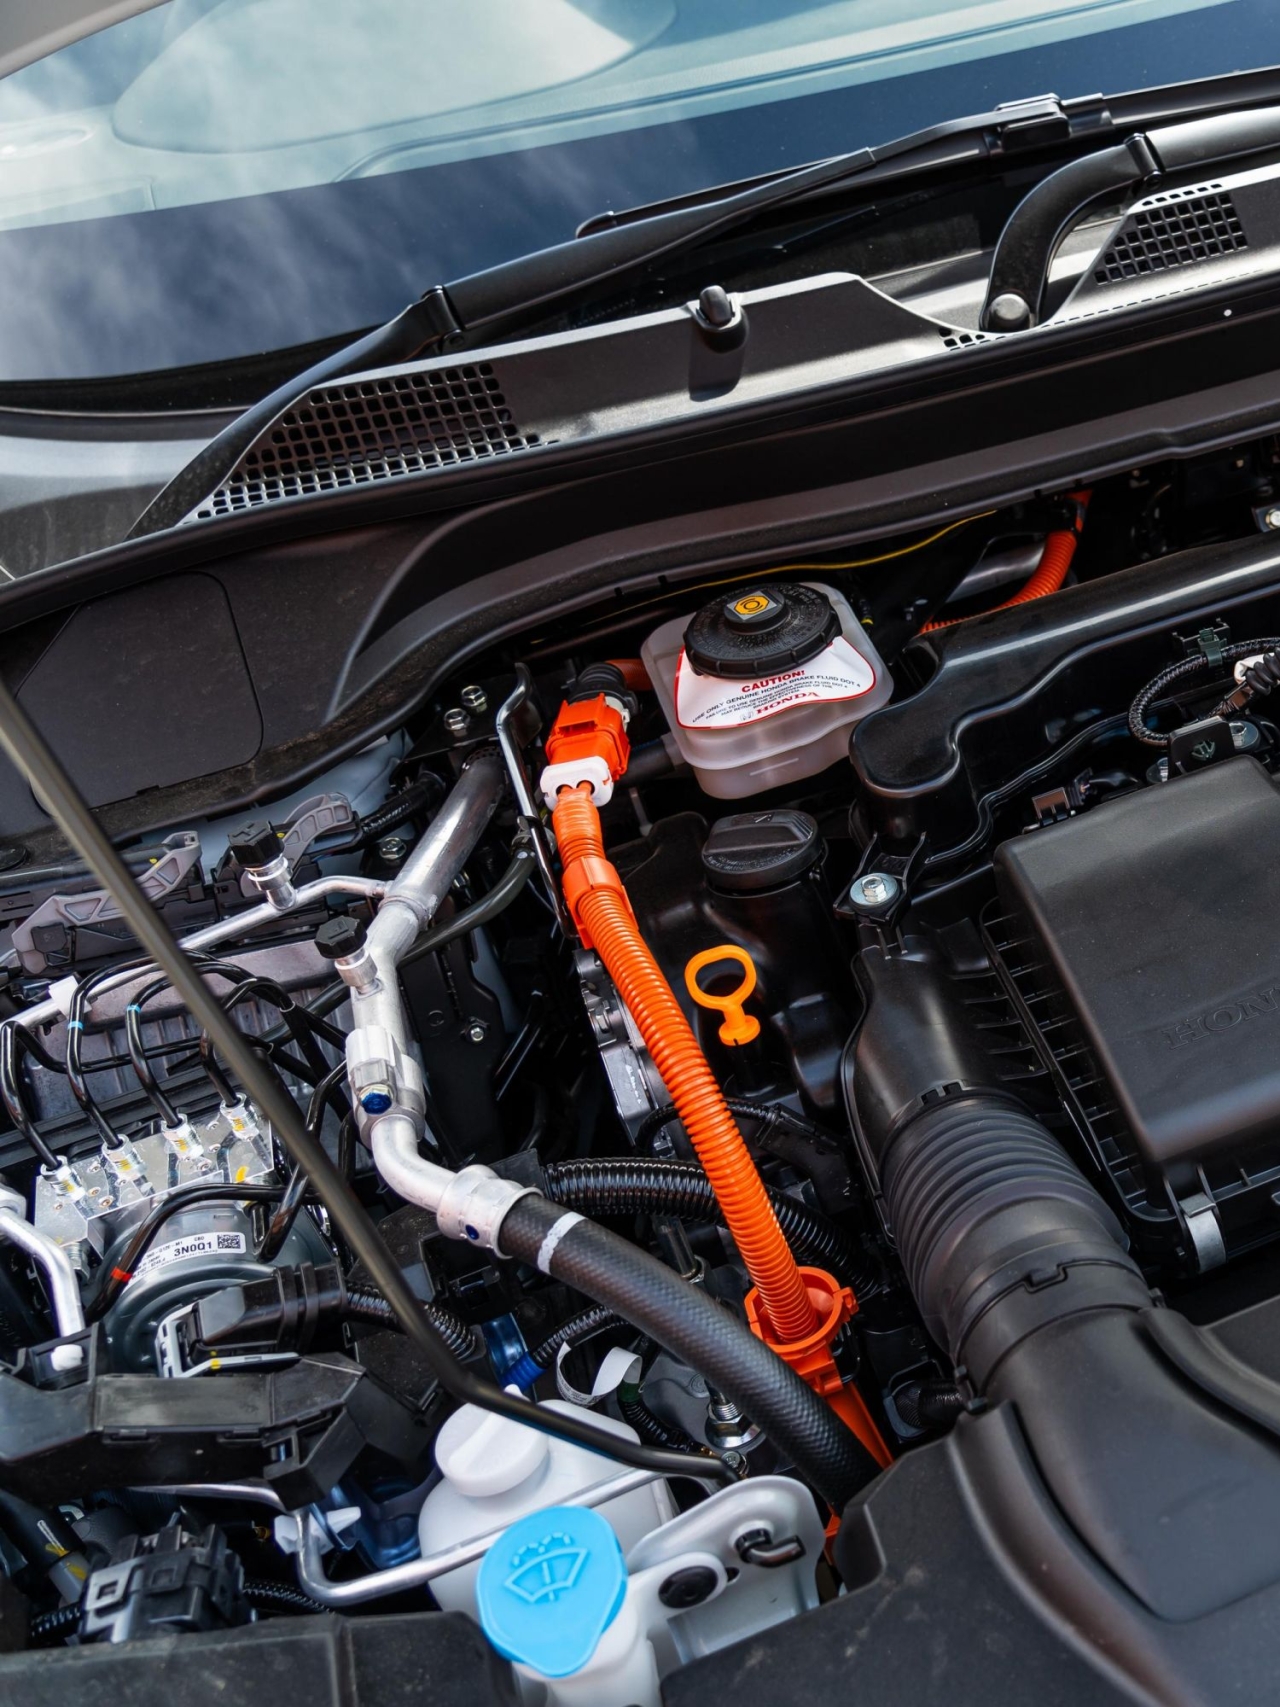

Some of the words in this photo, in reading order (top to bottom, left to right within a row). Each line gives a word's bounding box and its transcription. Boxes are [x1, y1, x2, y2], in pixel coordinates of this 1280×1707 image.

[741, 670, 805, 693] CAUTION!
[692, 712, 704, 723] USE
[706, 702, 724, 714] ONLY
[726, 691, 760, 704] GENUINE
[761, 682, 788, 694] HONDA
[789, 675, 815, 684] BRAKE
[756, 691, 821, 714] HONDA
[174, 1241, 212, 1257] 3N0Q1
